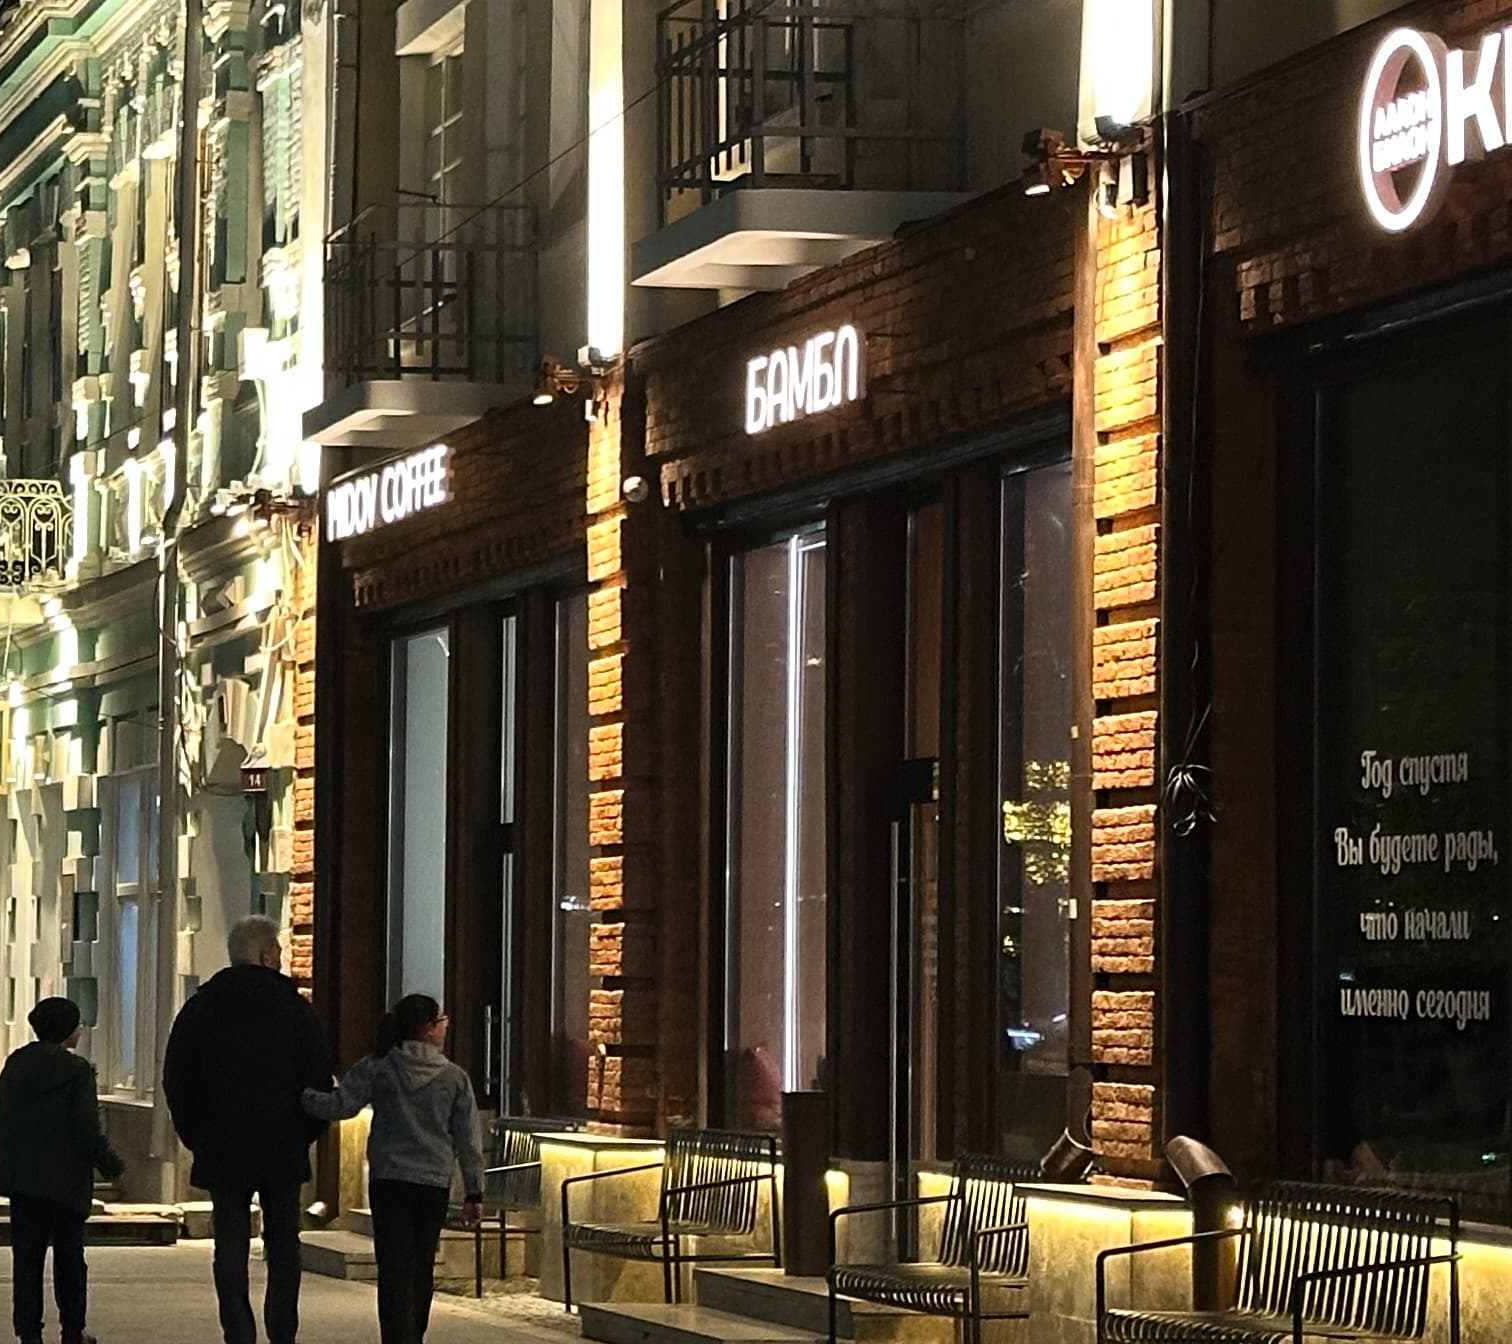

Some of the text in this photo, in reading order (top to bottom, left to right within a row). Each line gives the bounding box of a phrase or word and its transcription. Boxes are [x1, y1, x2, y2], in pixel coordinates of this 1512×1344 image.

[744, 323, 859, 435] БАМБЛ
[380, 443, 449, 524] COFFEE
[1360, 750, 1469, 798] Год спустя
[1334, 823, 1499, 875] Вы будете рады,
[1360, 908, 1472, 941] что начали
[1340, 988, 1491, 1031] именно сегодня
